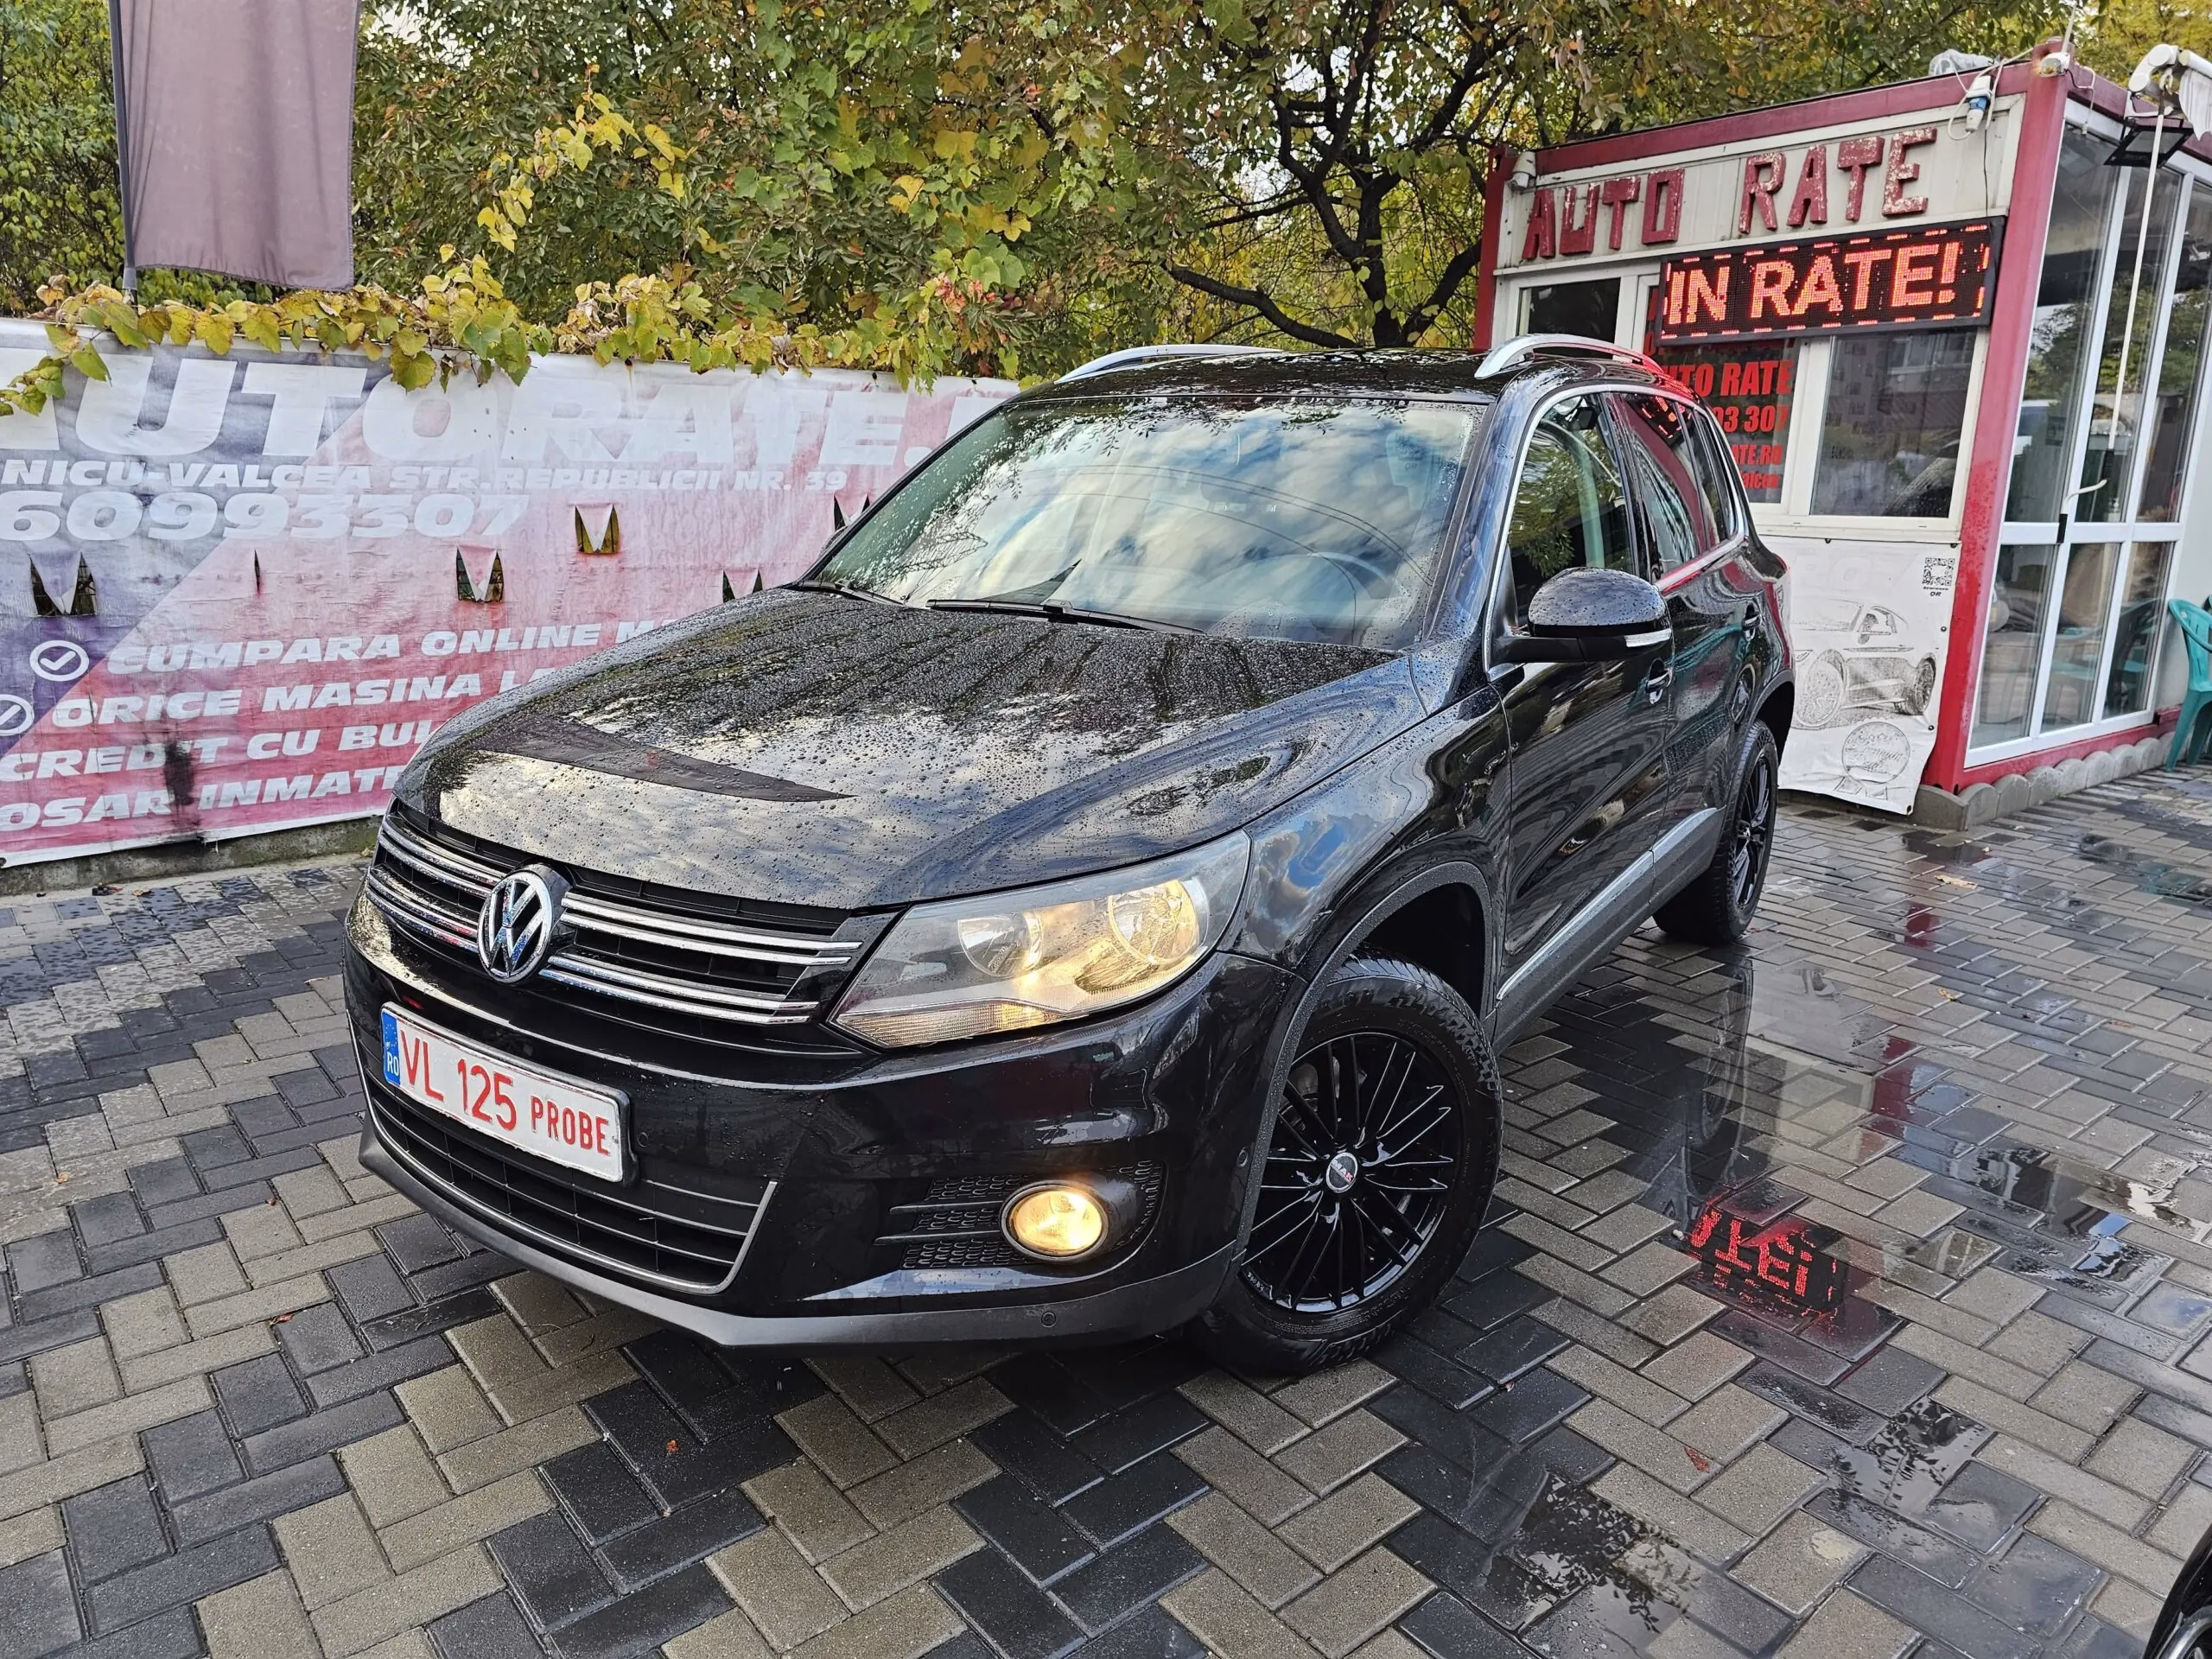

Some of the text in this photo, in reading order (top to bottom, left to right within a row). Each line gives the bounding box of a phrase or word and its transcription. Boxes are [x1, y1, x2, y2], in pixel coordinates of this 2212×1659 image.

[1521, 127, 1937, 260] AUTO RATE
[1668, 265, 1730, 326] IN
[1750, 241, 1960, 320] RATE!
[1720, 359, 1796, 397] RATE
[0, 347, 1009, 467] UTORATE.
[1744, 404, 1789, 432] 307
[804, 470, 848, 490] 39
[107, 633, 402, 675] CUMPARA
[421, 623, 601, 657] ONLINE
[52, 690, 243, 729] ORICE
[262, 671, 482, 712] MASINA
[246, 729, 321, 760] CU
[386, 1029, 612, 1157] RO VL 125 PROBE
